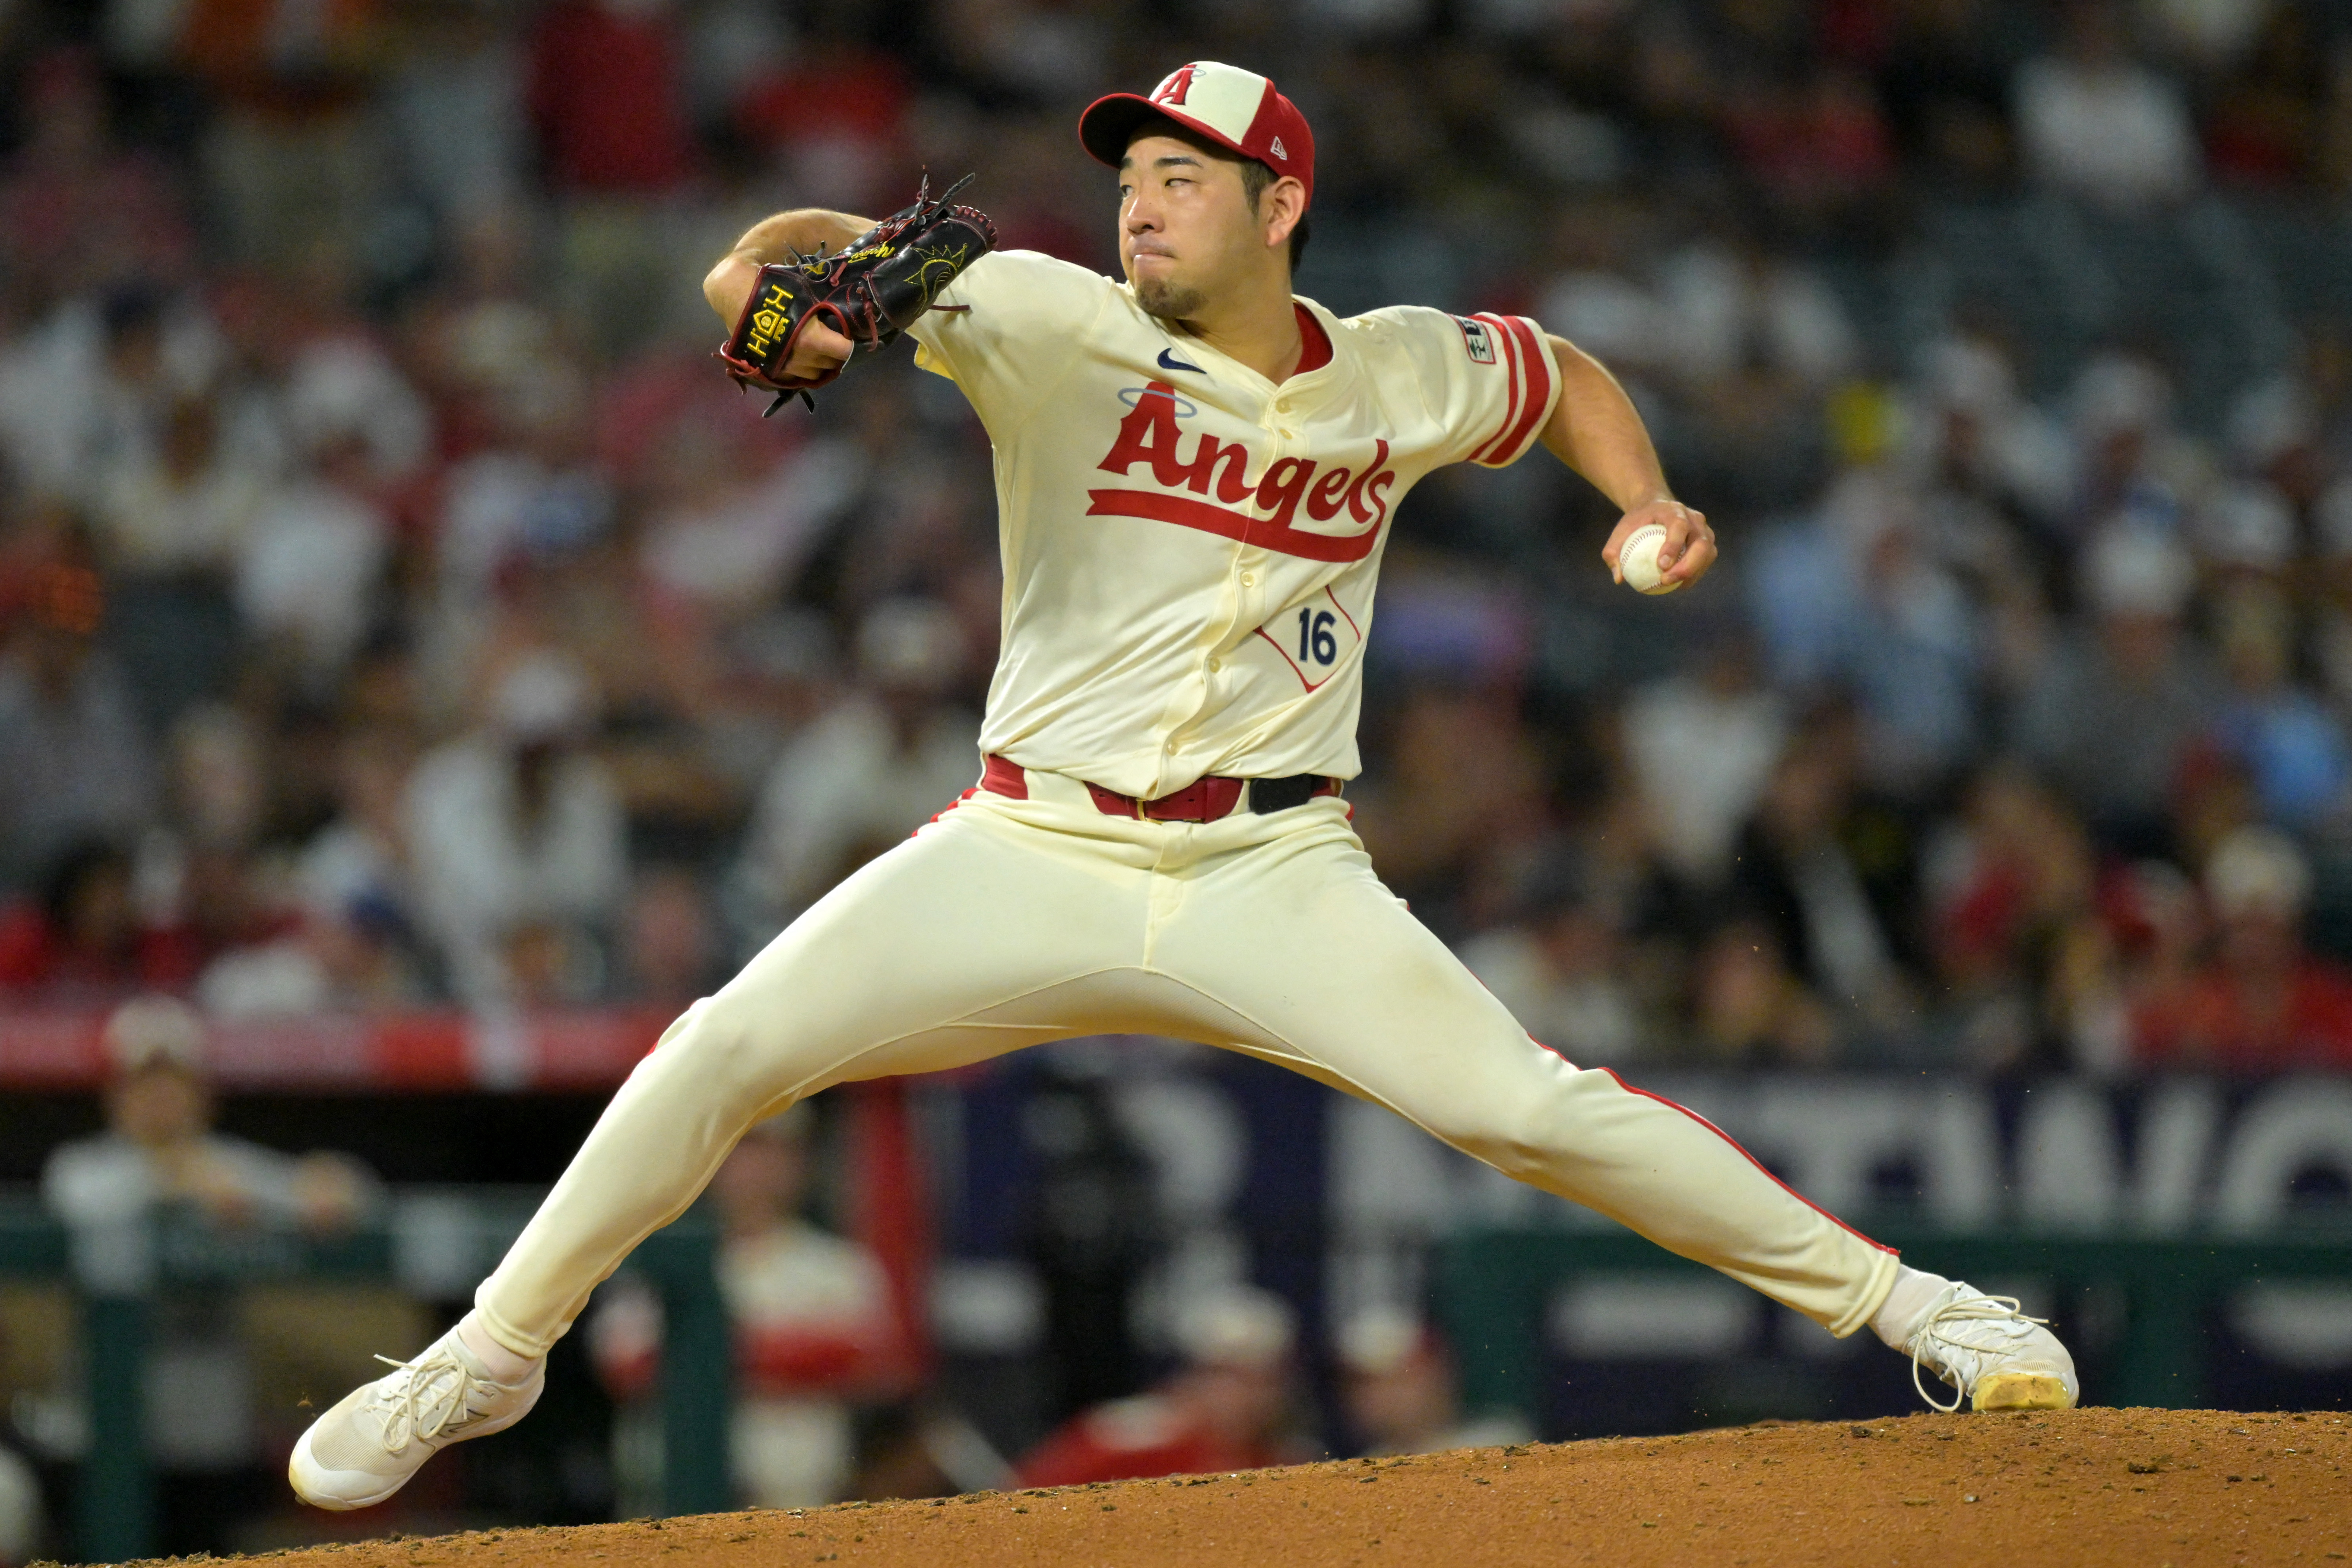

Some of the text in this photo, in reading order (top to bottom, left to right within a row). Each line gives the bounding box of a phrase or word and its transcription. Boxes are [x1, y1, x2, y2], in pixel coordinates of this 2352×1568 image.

[1153, 64, 1197, 106] A
[1096, 381, 1395, 531] Angels
[1298, 607, 1337, 666] 16
